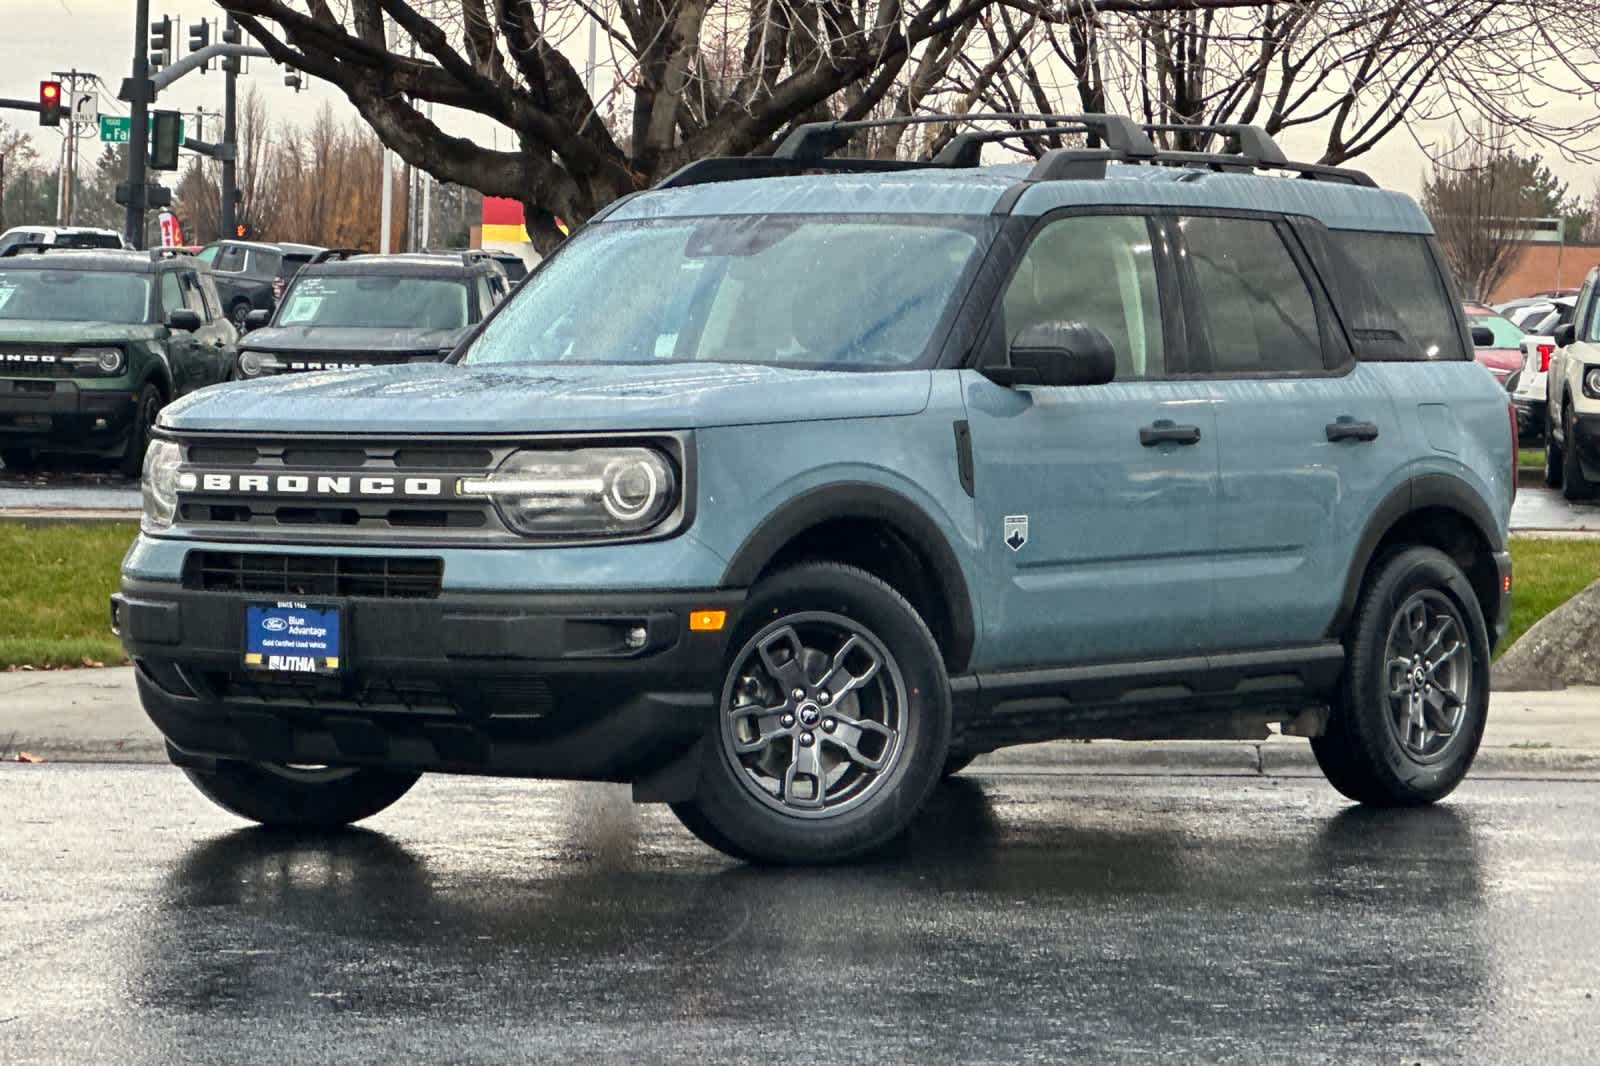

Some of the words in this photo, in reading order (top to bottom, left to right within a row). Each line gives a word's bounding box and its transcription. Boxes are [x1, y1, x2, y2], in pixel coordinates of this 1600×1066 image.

[0, 354, 56, 362] NCO
[203, 474, 441, 495] BRONCO
[288, 616, 305, 625] Blue
[288, 626, 327, 637] Advantage
[262, 639, 275, 647] Gold
[275, 640, 295, 648] Certified
[280, 655, 316, 672] LITHIA
